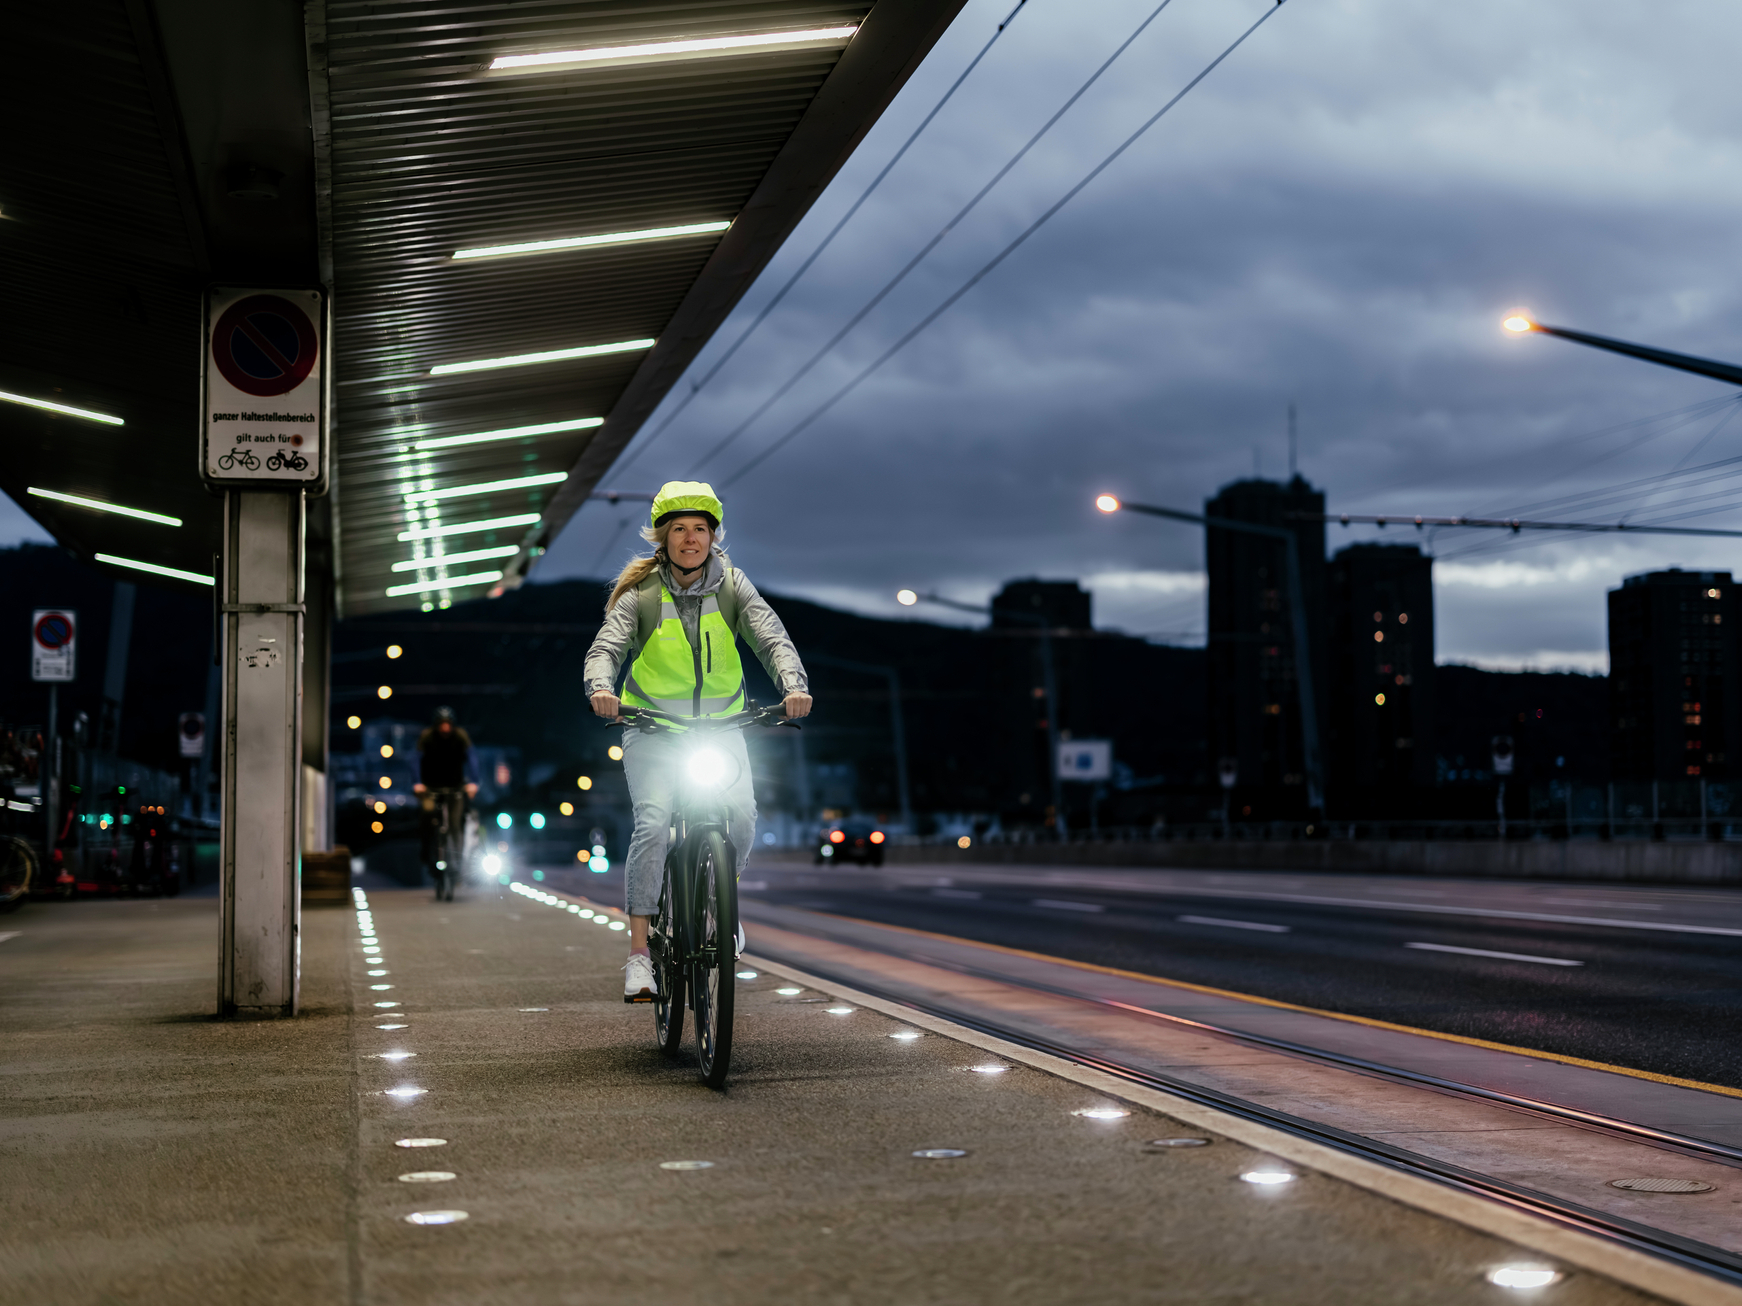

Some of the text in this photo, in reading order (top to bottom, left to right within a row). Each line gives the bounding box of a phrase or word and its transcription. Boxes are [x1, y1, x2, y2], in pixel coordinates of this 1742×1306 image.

[212, 411, 315, 423] ganzer Haltestellenbereich
[236, 433, 291, 444] gilt auch für
